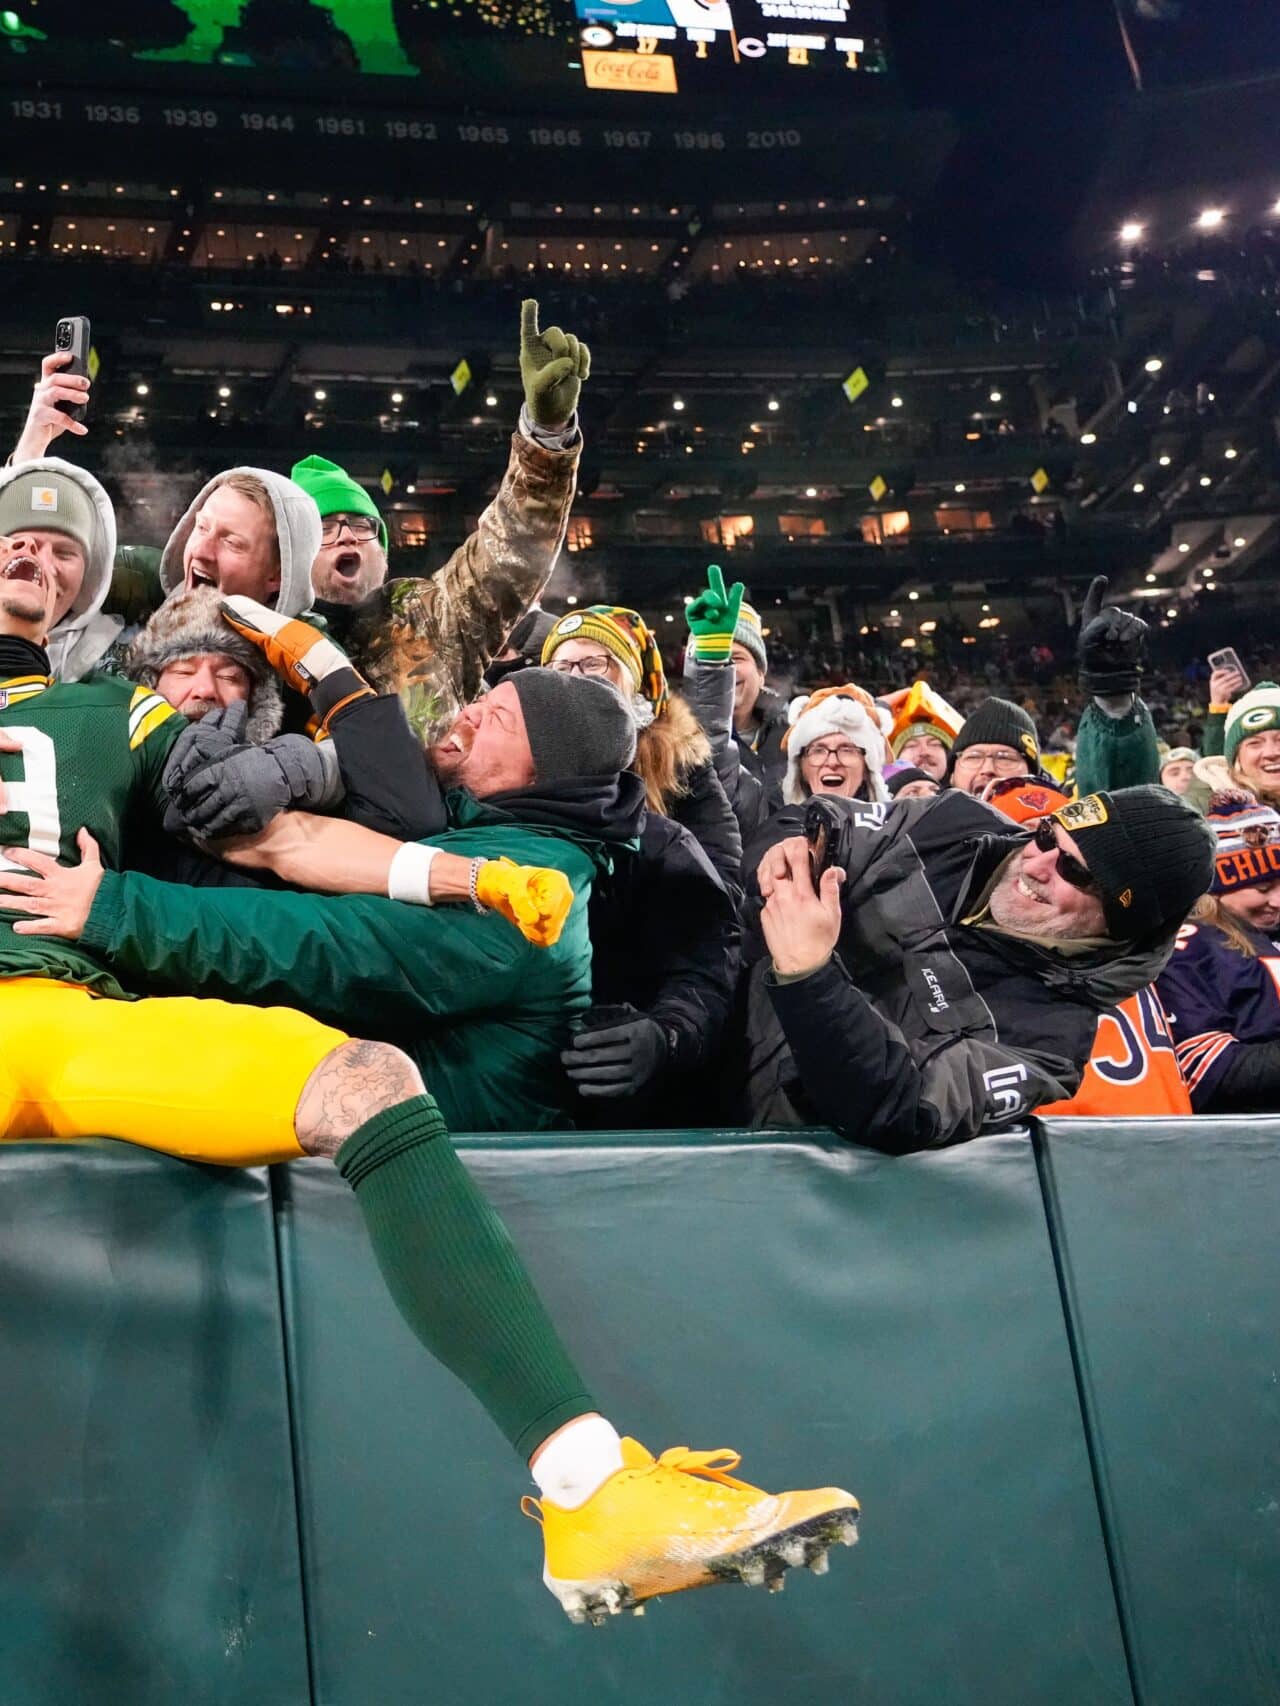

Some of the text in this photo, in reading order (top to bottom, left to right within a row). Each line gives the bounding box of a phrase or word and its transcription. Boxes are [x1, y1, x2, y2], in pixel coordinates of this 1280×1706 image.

[10, 100, 63, 120] 1931
[84, 104, 141, 124] 1936
[162, 109, 218, 128] 1939
[239, 113, 294, 132] 1944
[315, 117, 365, 136] 1961
[384, 121, 437, 140] 1962
[457, 125, 509, 144] 1965
[528, 128, 582, 147] 1966
[603, 130, 651, 148] 1967
[747, 129, 801, 149] 2010
